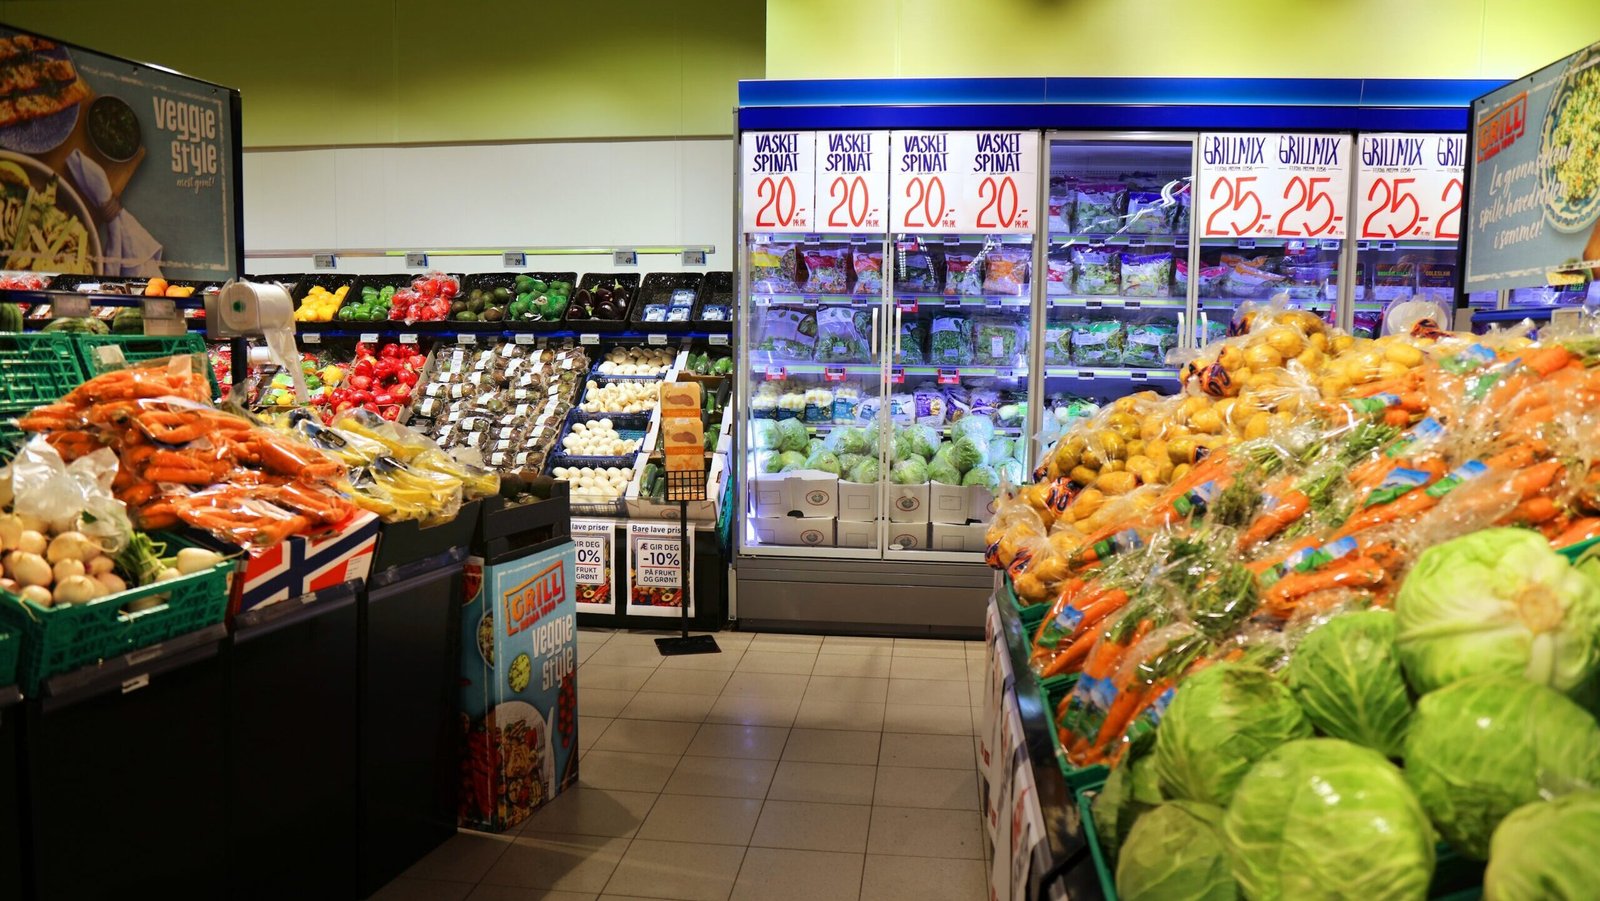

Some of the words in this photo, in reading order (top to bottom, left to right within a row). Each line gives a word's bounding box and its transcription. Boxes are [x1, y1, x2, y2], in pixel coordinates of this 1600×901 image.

[1479, 105, 1523, 151] GRILL
[755, 133, 799, 153] VASKET
[829, 133, 872, 153] VASKET
[904, 133, 949, 153] VASKET
[976, 133, 1022, 153] VASKET
[1204, 136, 1265, 165] GRILLMIX
[1279, 136, 1341, 165] GRILLMIX
[1362, 138, 1424, 166] GRILLMIX
[1437, 137, 1465, 166] GRIL
[752, 153, 799, 172] SPINAT
[825, 153, 874, 172] SPINAT
[901, 153, 949, 172] SPINAT
[973, 153, 1022, 172] SPINAT
[588, 524, 609, 532] priser
[632, 525, 649, 533] Bare
[650, 543, 663, 551] GIR
[643, 552, 680, 566] -10%
[654, 569, 676, 577] FRUKT
[511, 573, 561, 622] GRILL
